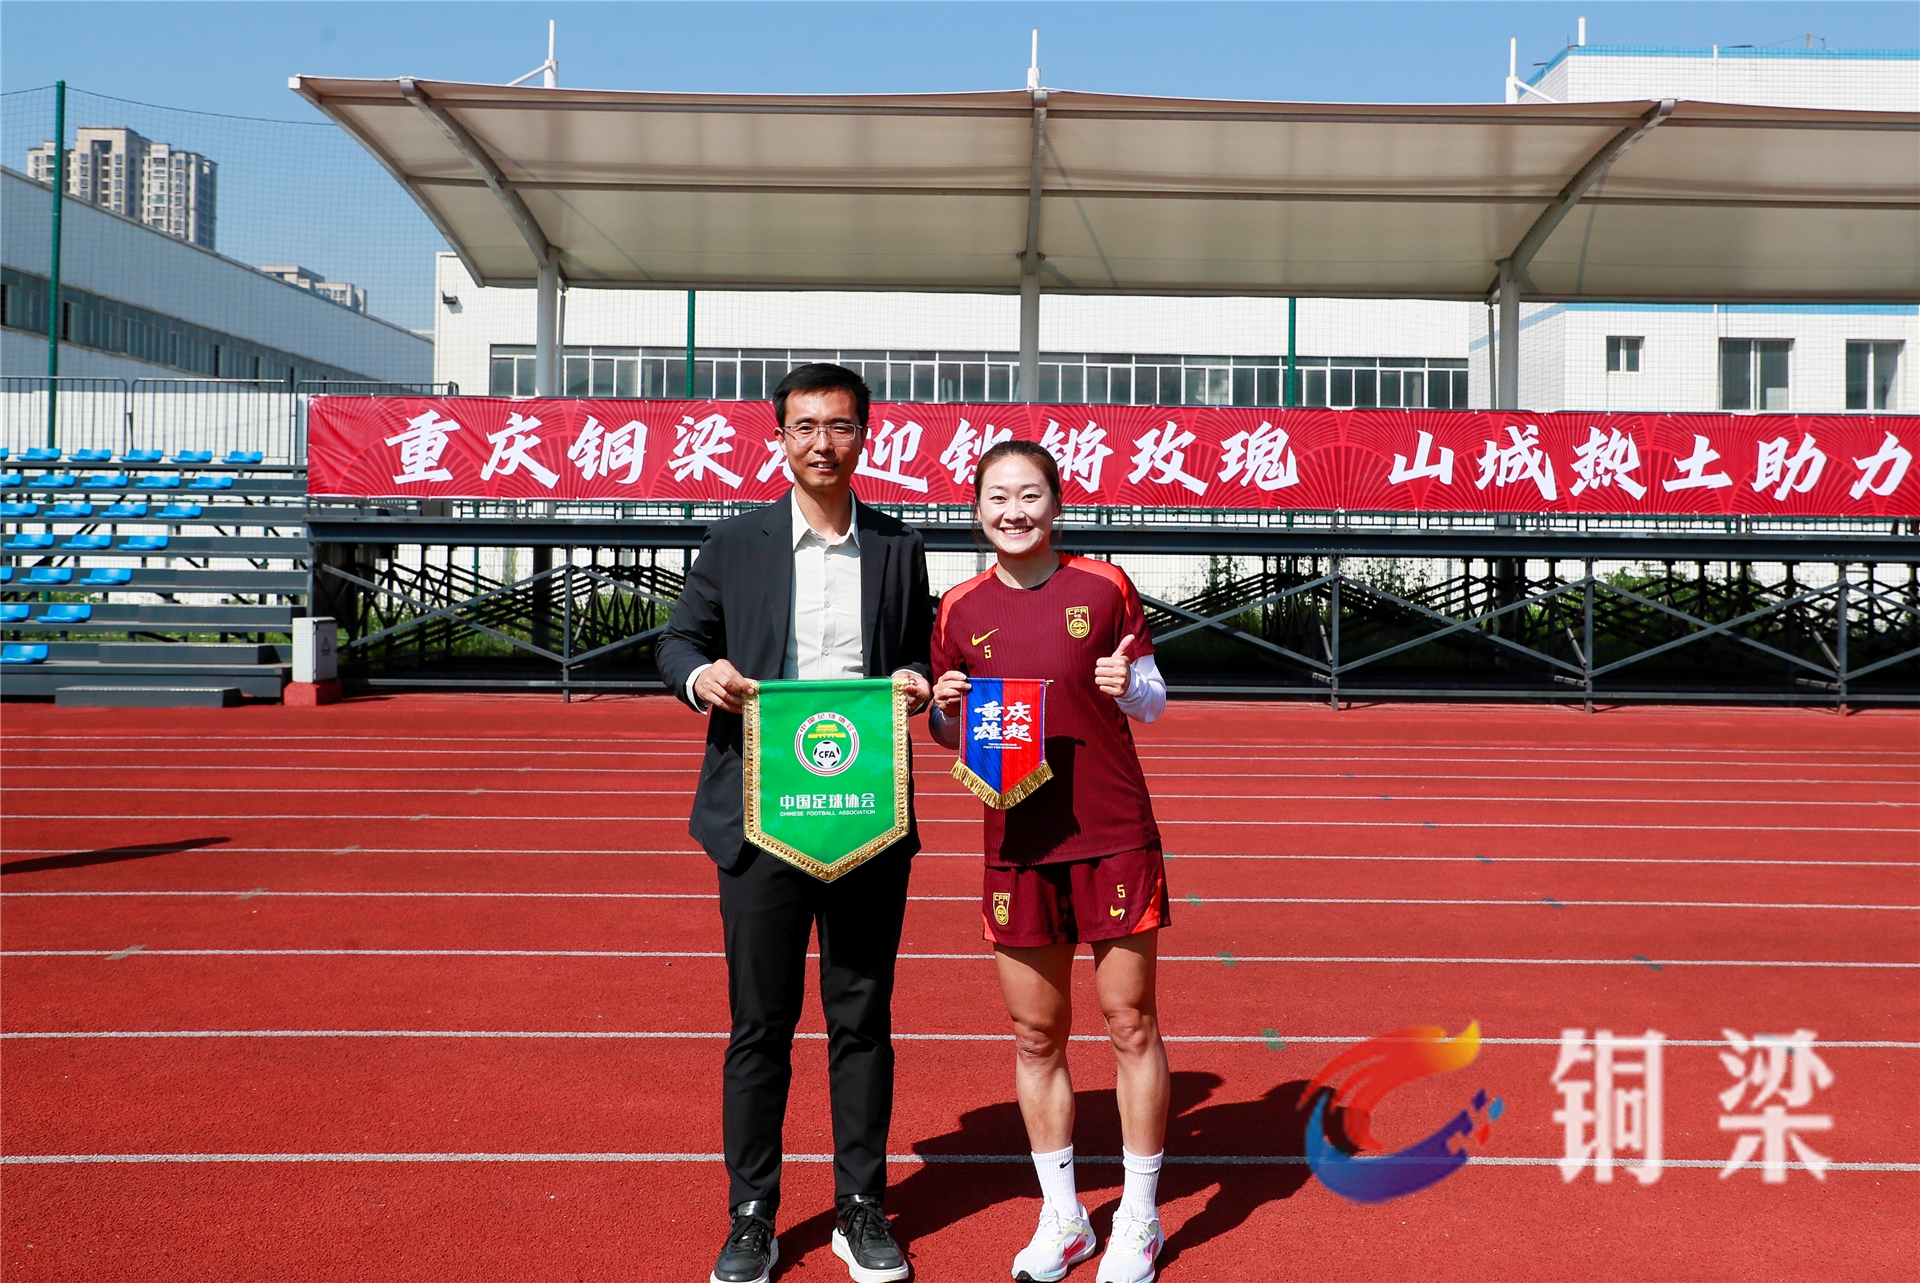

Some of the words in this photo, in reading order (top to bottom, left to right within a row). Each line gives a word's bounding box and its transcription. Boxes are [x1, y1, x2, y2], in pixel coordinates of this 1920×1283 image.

[1388, 424, 1913, 501] 山城热土助力
[984, 645, 992, 659] 5
[974, 701, 1032, 722] 重庆
[973, 722, 1032, 742] 雄起
[780, 793, 875, 810] 中国足球协会
[1116, 884, 1126, 899] 5
